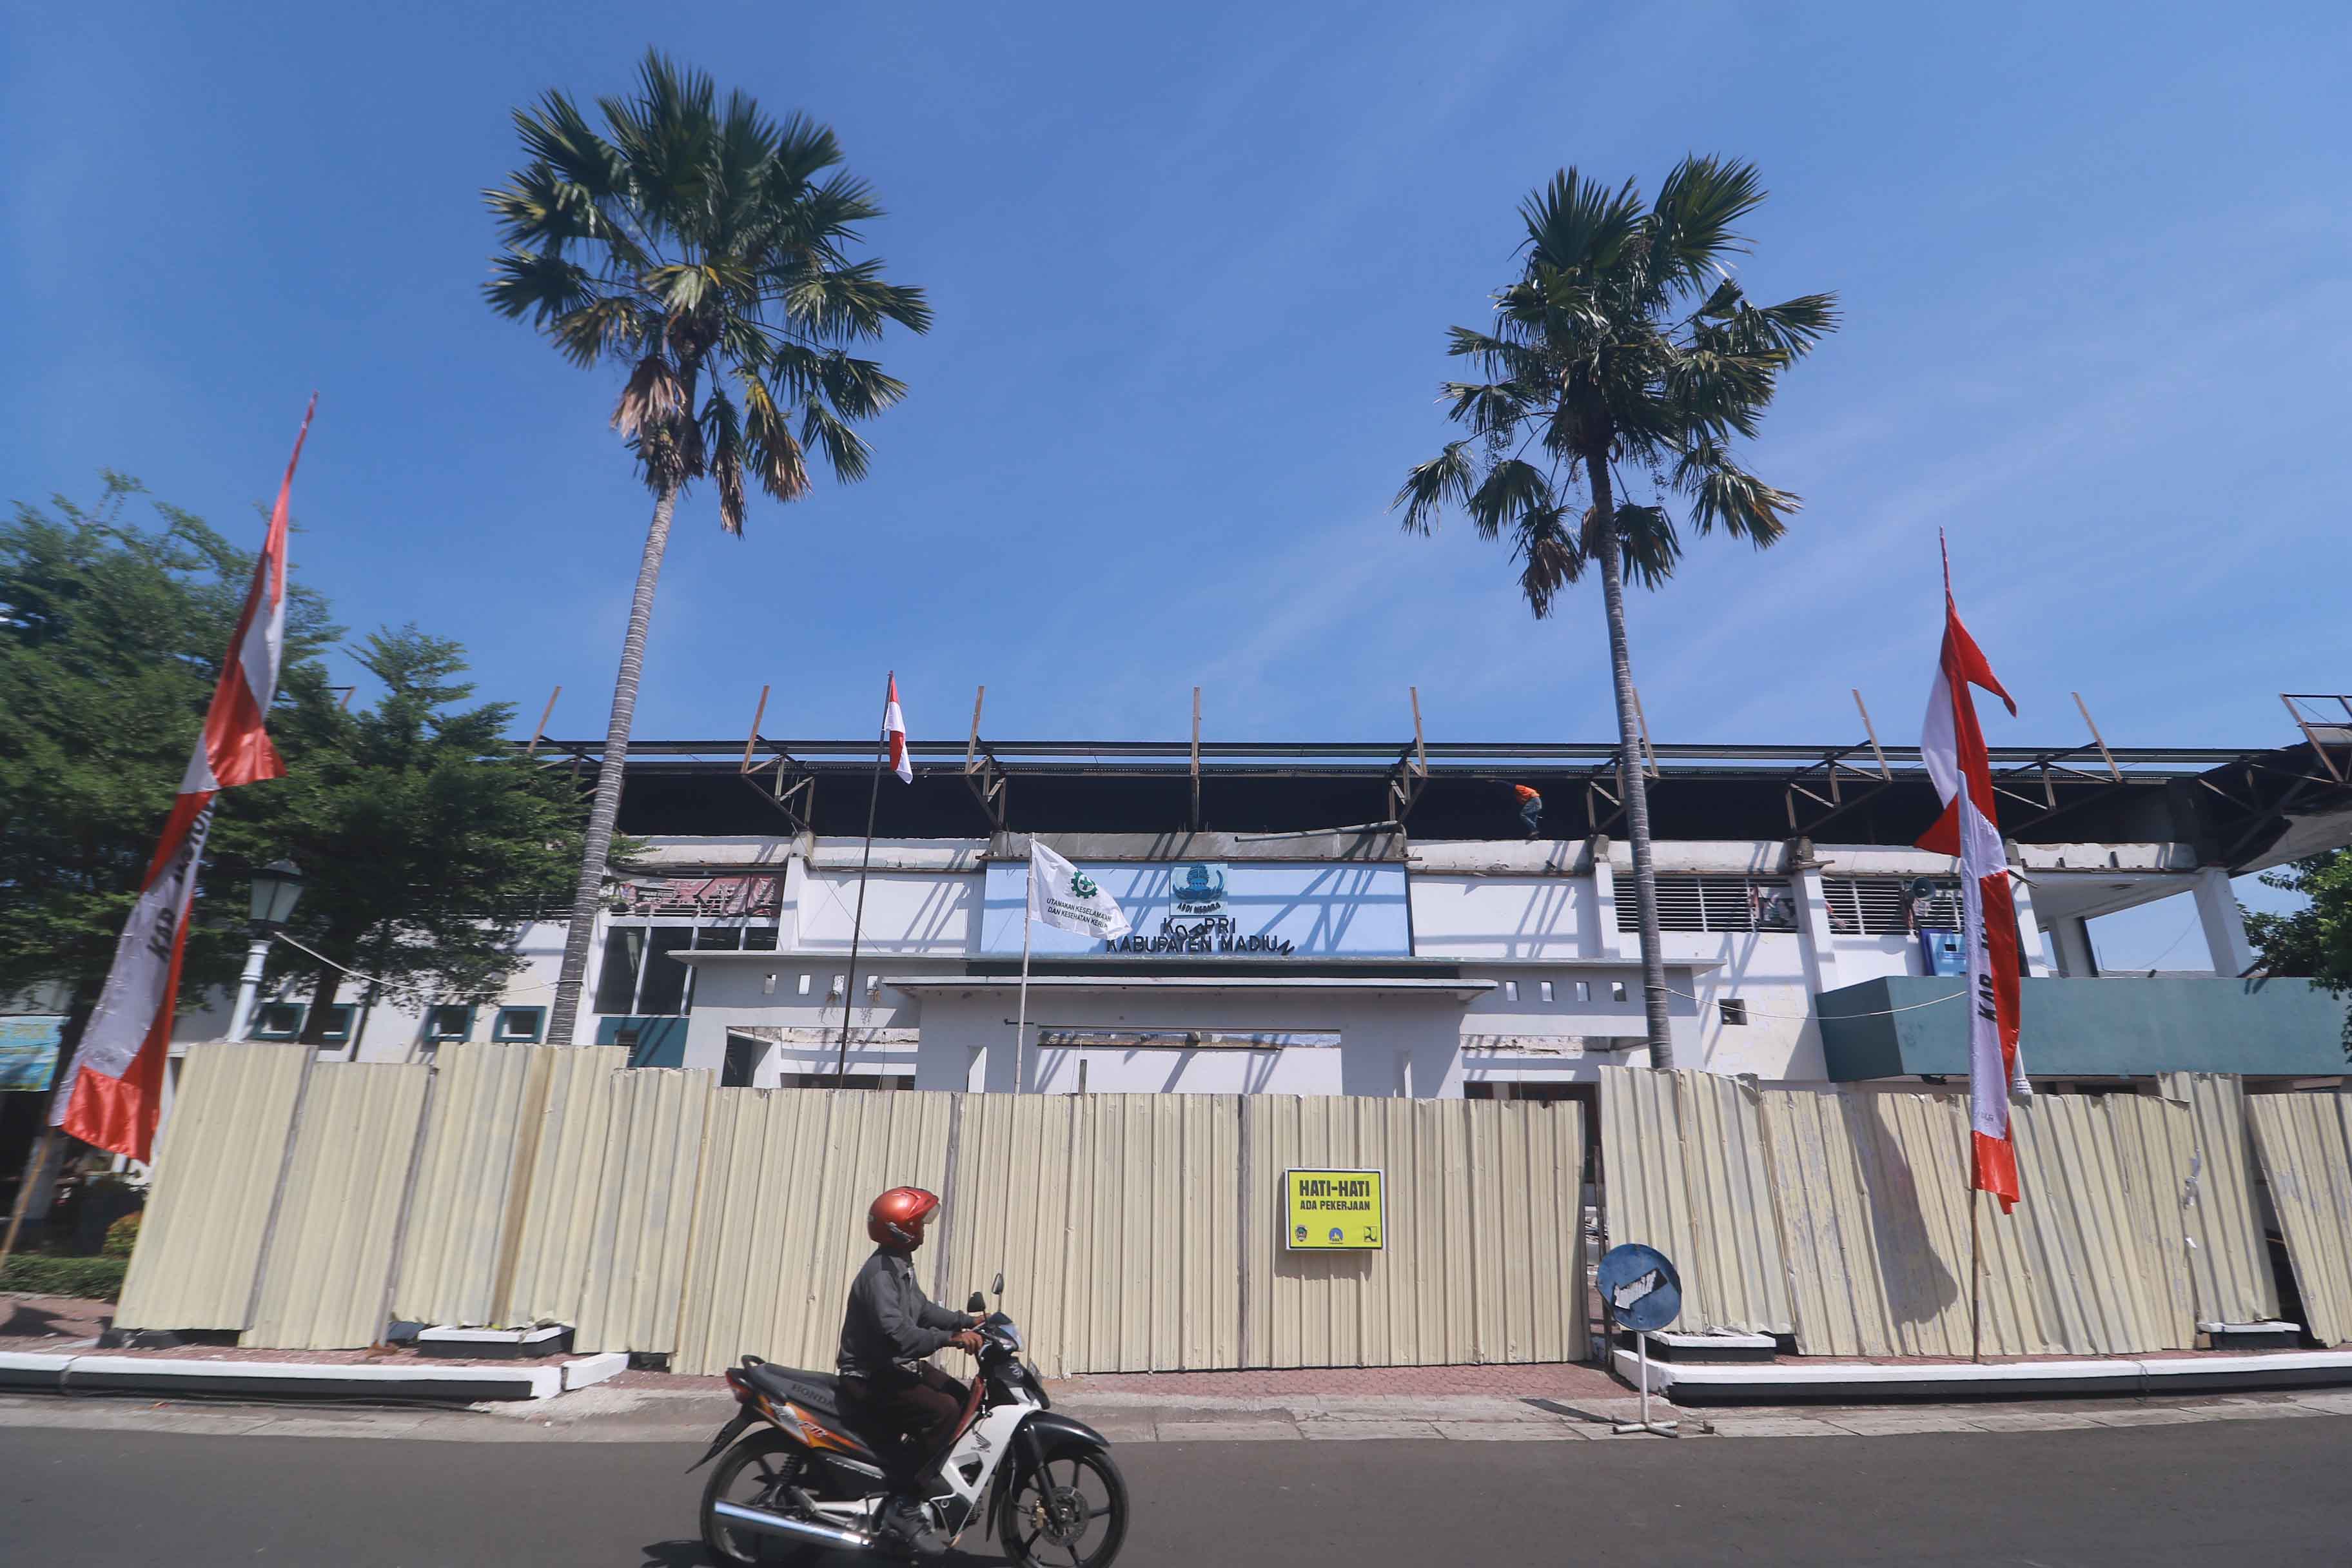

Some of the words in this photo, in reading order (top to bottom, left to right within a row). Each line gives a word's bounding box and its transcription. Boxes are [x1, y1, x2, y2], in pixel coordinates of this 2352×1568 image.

[1046, 897, 1075, 911] UTAMAKAN
[1177, 902, 1192, 913] ABDI
[1048, 906, 1060, 916] DAN
[1061, 910, 1090, 924] KESEHATAN
[1106, 935, 1212, 953] KABUPATEN
[1220, 935, 1295, 956] MADIUN
[1300, 1180, 1370, 1197] HATI-HATI
[1300, 1200, 1317, 1210] ADA
[1320, 1200, 1370, 1210] PEKERJAAN
[792, 1384, 835, 1407] HONDA
